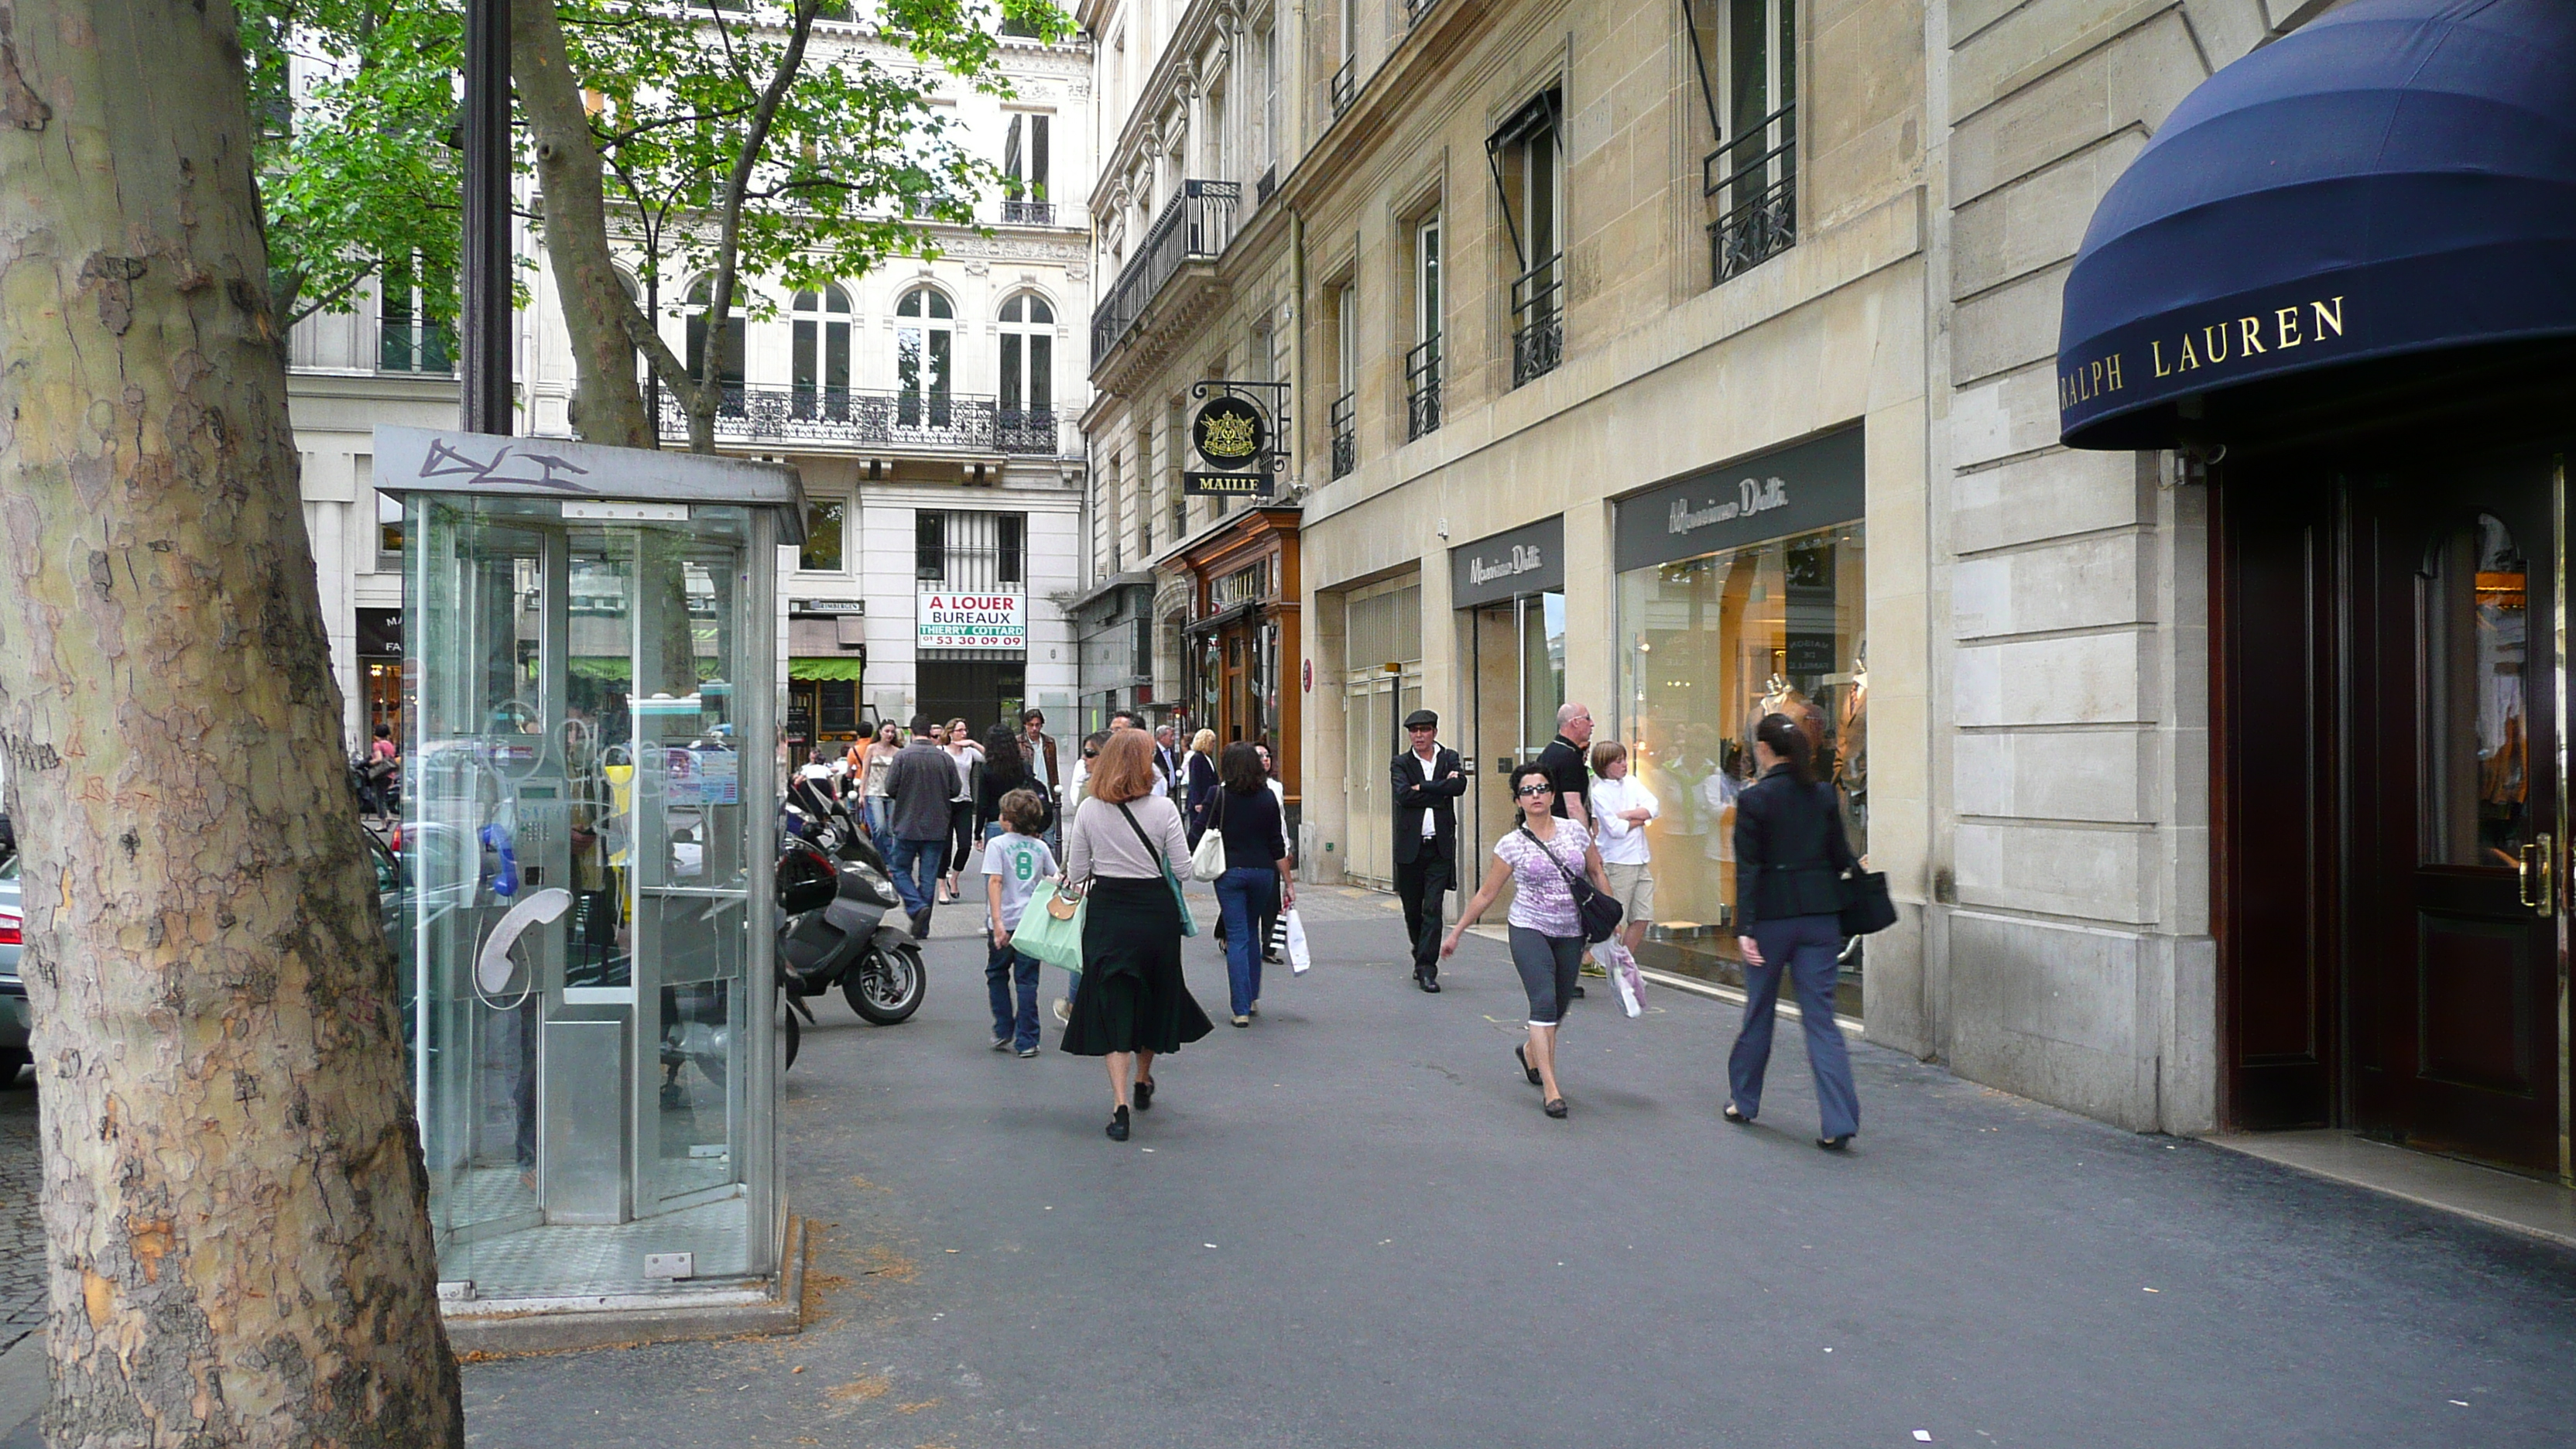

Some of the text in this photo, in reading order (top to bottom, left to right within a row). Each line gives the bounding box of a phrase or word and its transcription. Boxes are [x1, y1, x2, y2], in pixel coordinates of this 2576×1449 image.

[2061, 296, 2345, 410] RALPH LAUREN
[1199, 478, 1259, 491] MAILLE
[929, 596, 1014, 610] A LOUER
[933, 611, 1010, 624] BUREAUX
[921, 625, 1023, 635] THIERRY COTTARD
[937, 636, 953, 645] 53
[958, 636, 975, 645] 30
[1003, 637, 1020, 646] 09
[1016, 851, 1032, 880] 8
